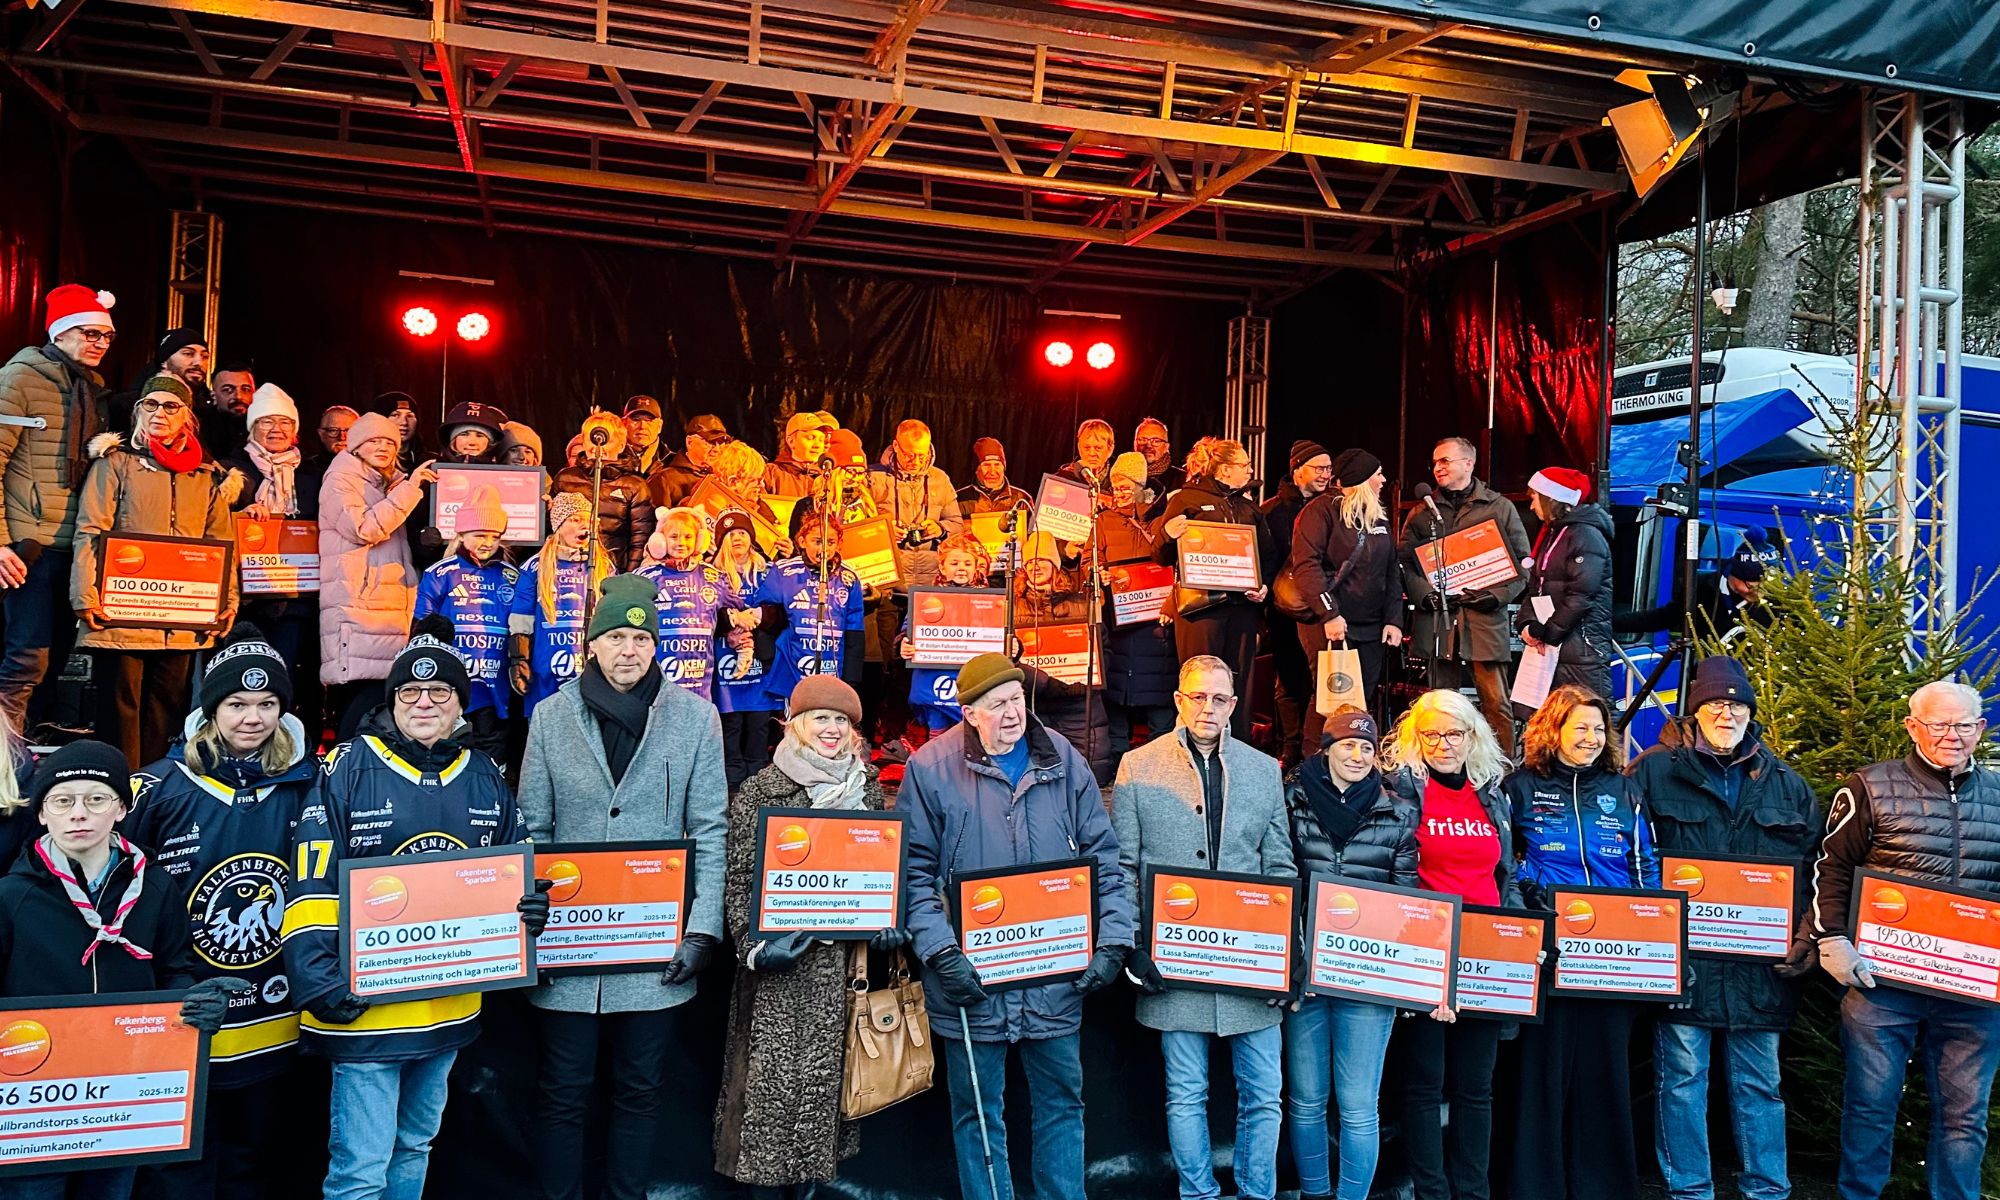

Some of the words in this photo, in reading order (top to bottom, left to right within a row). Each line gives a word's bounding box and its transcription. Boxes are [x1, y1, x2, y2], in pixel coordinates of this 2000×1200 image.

[1614, 395, 1655, 412] THERMO
[1658, 391, 1684, 403] KING
[1046, 508, 1059, 516] 130
[1061, 512, 1077, 521] 000
[246, 557, 256, 566] 15
[259, 557, 277, 565] 500
[1467, 560, 1477, 568] kr
[113, 580, 136, 590] 100
[141, 581, 167, 592] 000
[171, 583, 184, 592] kr
[470, 582, 494, 590] Grand
[674, 585, 696, 593] Grand
[1129, 592, 1143, 600] 000
[920, 628, 938, 637] 100
[942, 628, 963, 637] 000
[967, 629, 976, 637] kr
[661, 639, 707, 652] TOSPE
[1038, 657, 1056, 665] 000
[422, 778, 438, 786] FHK
[1427, 817, 1492, 837] friskis
[298, 840, 334, 882] 17
[456, 867, 497, 878] Falkenbergs
[632, 866, 661, 874] Sparbank
[464, 876, 497, 886] Sparbank
[773, 874, 793, 888] 45
[798, 874, 828, 888] 000
[833, 874, 848, 888] kr
[1039, 877, 1070, 886] Falkenbergs
[1046, 884, 1070, 893] Sparbank
[1236, 889, 1270, 899] Falkenbergs
[772, 898, 846, 908] Gymnastikföreningen
[848, 900, 860, 908] Wig
[1242, 897, 1269, 906] Sparbank
[1398, 902, 1431, 914] Falkenbergs
[1696, 905, 1723, 918] 250
[1727, 907, 1742, 919] kr
[191, 913, 203, 921] 20
[567, 909, 602, 923] 000
[608, 907, 625, 922] kr
[1404, 911, 1430, 920] Sparbank
[364, 930, 390, 947] 60
[396, 926, 436, 944] 000
[442, 923, 461, 939] kr
[481, 925, 517, 936] 2025-11-22
[574, 931, 665, 943] Bevattningssamfällighet
[974, 932, 991, 946] 22
[996, 927, 1025, 942] 000
[1030, 925, 1044, 938] kr
[1059, 926, 1086, 935] 2025-11-22
[1164, 927, 1183, 940] 25
[1187, 929, 1219, 943] 000
[1223, 932, 1238, 946] kr
[1254, 943, 1284, 952] 2025-11-22
[1876, 926, 1899, 945] 195
[1901, 932, 1931, 950] 000
[1934, 939, 1947, 954] kr
[1048, 942, 1083, 953] Falkenberg
[1325, 935, 1344, 949] 50
[1350, 939, 1380, 955] 000
[1384, 944, 1400, 958] kr
[1414, 957, 1443, 967] 2025-11-22
[1565, 941, 1590, 953] 270
[1595, 942, 1623, 955] 000
[1628, 944, 1641, 956] kr
[359, 955, 412, 969] Falkenbergs
[414, 949, 472, 963] Hockeyklubb
[1016, 966, 1025, 974] till
[1026, 964, 1036, 973] vår
[1322, 957, 1355, 969] Harplinge
[1356, 962, 1386, 974] ridklubb
[1476, 962, 1490, 974] kr
[1560, 962, 1608, 970] Idrottsklubben
[446, 970, 462, 979] och
[464, 968, 481, 979] laga
[1472, 984, 1507, 993] Falkenberg
[114, 1014, 166, 1026] Falkenbergs
[124, 1024, 166, 1036] Sparbank
[28, 1083, 78, 1104] 500
[86, 1082, 111, 1100] kr
[138, 1086, 185, 1097] 2025-11-22
[82, 1112, 132, 1125] Scoutkår
